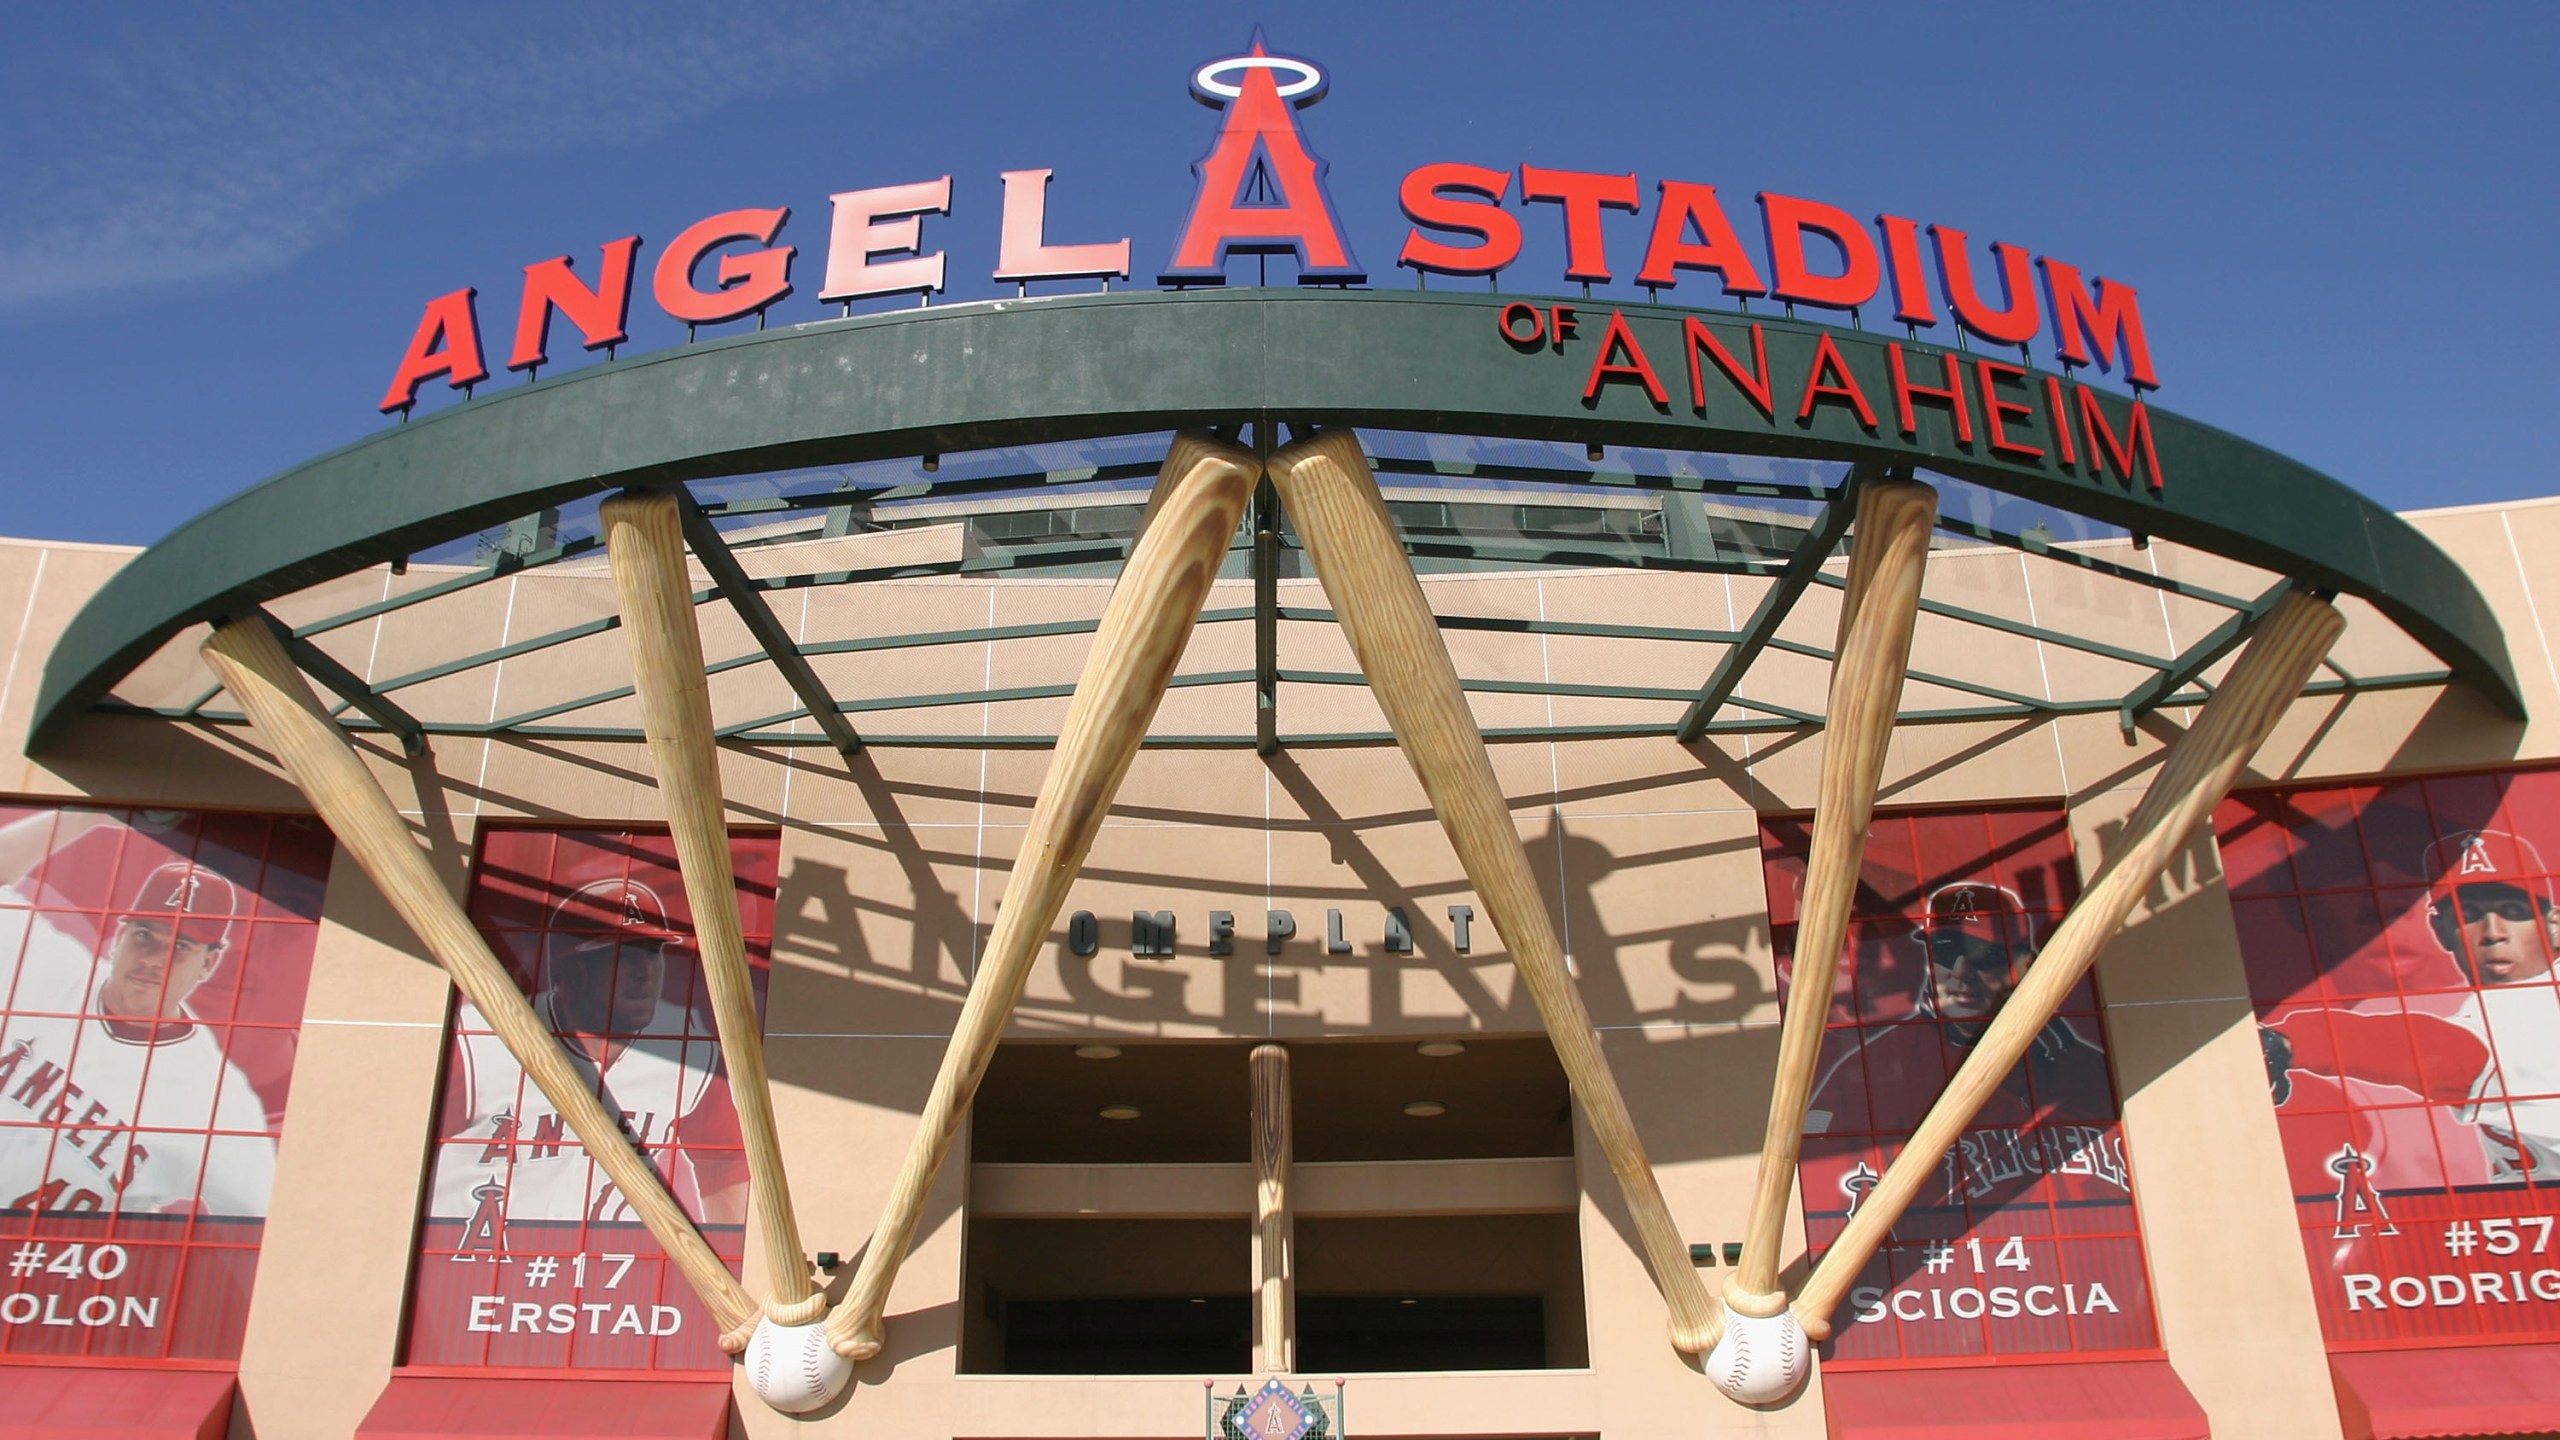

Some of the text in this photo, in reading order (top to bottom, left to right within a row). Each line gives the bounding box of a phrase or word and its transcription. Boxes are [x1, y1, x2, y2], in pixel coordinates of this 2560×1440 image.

[379, 168, 1131, 415] ANGEL
[1397, 162, 2160, 392] STADIUM
[1498, 302, 2164, 494] OF ANAHEIM
[1923, 1236, 2031, 1275] #14
[2445, 1216, 2554, 1257] #57
[9, 1241, 128, 1280] #40
[525, 1252, 635, 1289] #17
[467, 1295, 682, 1337] ERSTAD
[1850, 1282, 2119, 1324] SCIOSCIA
